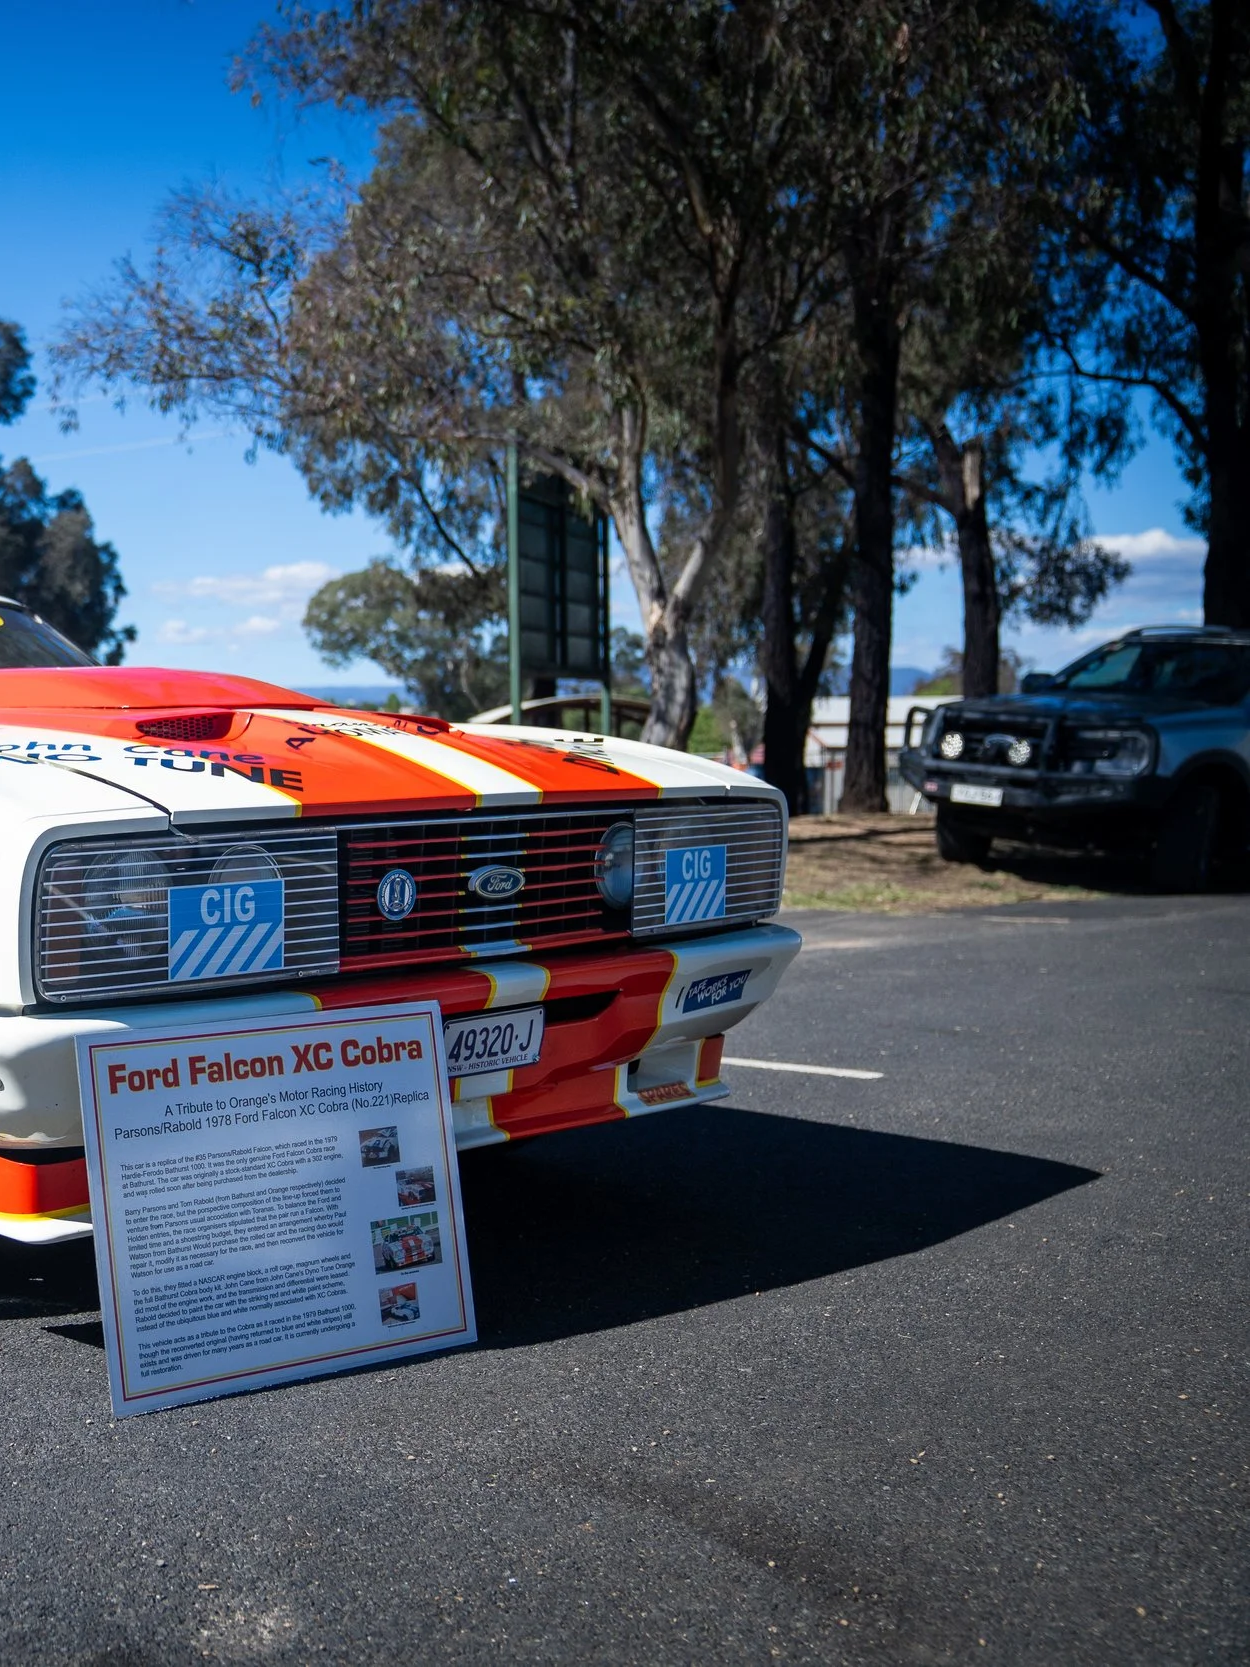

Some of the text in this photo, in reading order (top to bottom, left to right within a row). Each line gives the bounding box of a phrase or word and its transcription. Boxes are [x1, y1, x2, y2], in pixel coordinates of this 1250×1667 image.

[123, 745, 266, 765] Cane
[124, 756, 304, 792] TUNE
[681, 850, 712, 879] CIG
[487, 874, 513, 891] Ford
[199, 886, 256, 925] CIG
[688, 979, 708, 999] TAFE
[697, 975, 728, 1003] WORKS
[711, 973, 748, 1005] FOR YOU
[107, 1035, 423, 1094] Ford Falcon XC Cobra
[468, 1059, 499, 1070] HISTORIC
[501, 1053, 528, 1065] VEHICLE
[163, 1081, 383, 1117] A Tribute to Orange's Motor Racing History
[113, 1090, 429, 1140] Parsons/Rabold 1978 Ford Falcon XC Cobra (No.221)Replica
